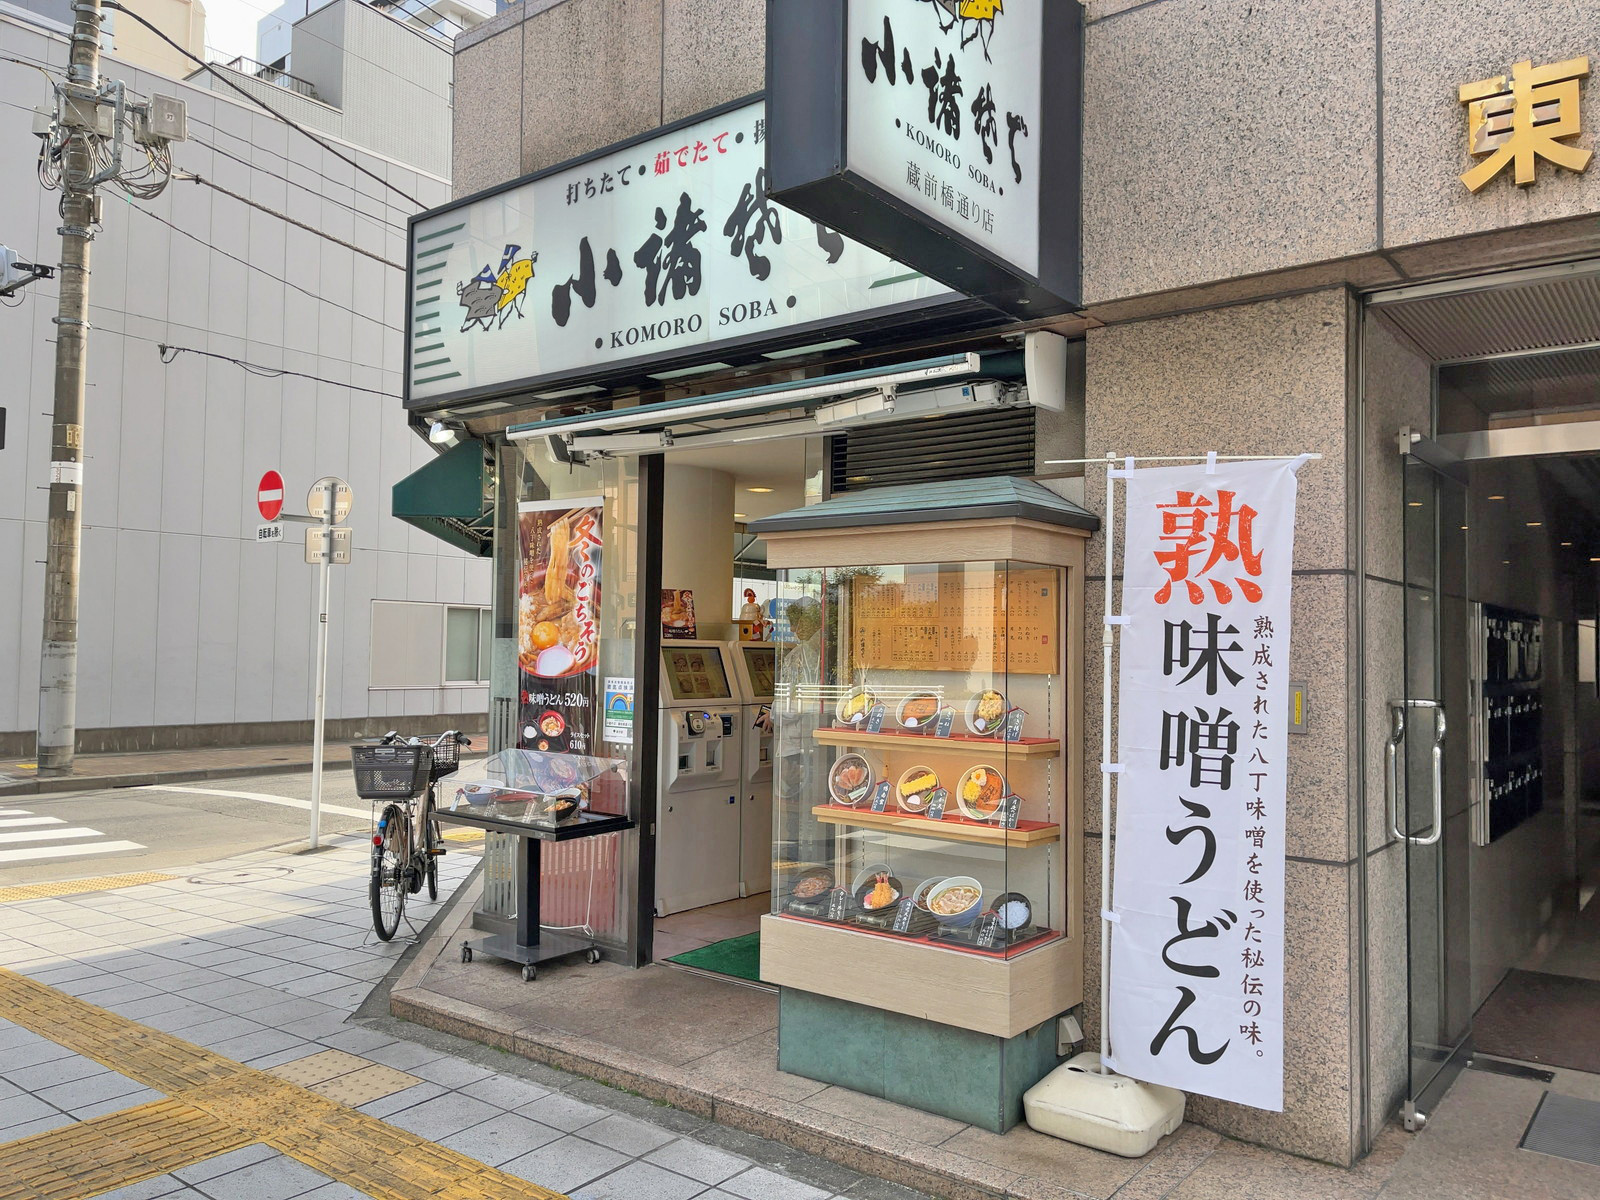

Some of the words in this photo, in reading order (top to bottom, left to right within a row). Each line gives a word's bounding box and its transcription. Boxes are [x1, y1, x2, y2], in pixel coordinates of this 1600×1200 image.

[905, 122, 961, 170] KOMORO
[968, 164, 996, 195] SOBA
[1459, 55, 1594, 195] 東
[905, 160, 995, 235] 蔵前橋通り店
[610, 314, 703, 349] KOMORO
[718, 297, 778, 327] SOBA
[568, 514, 603, 662] 冬のごちそう
[564, 692, 589, 708] 520円
[1012, 713, 1022, 737] かき揚げ
[1149, 489, 1264, 1066] 熟味噌うどん
[1239, 615, 1275, 1058] 熟成された八丁味噌を使った秘伝の味。
